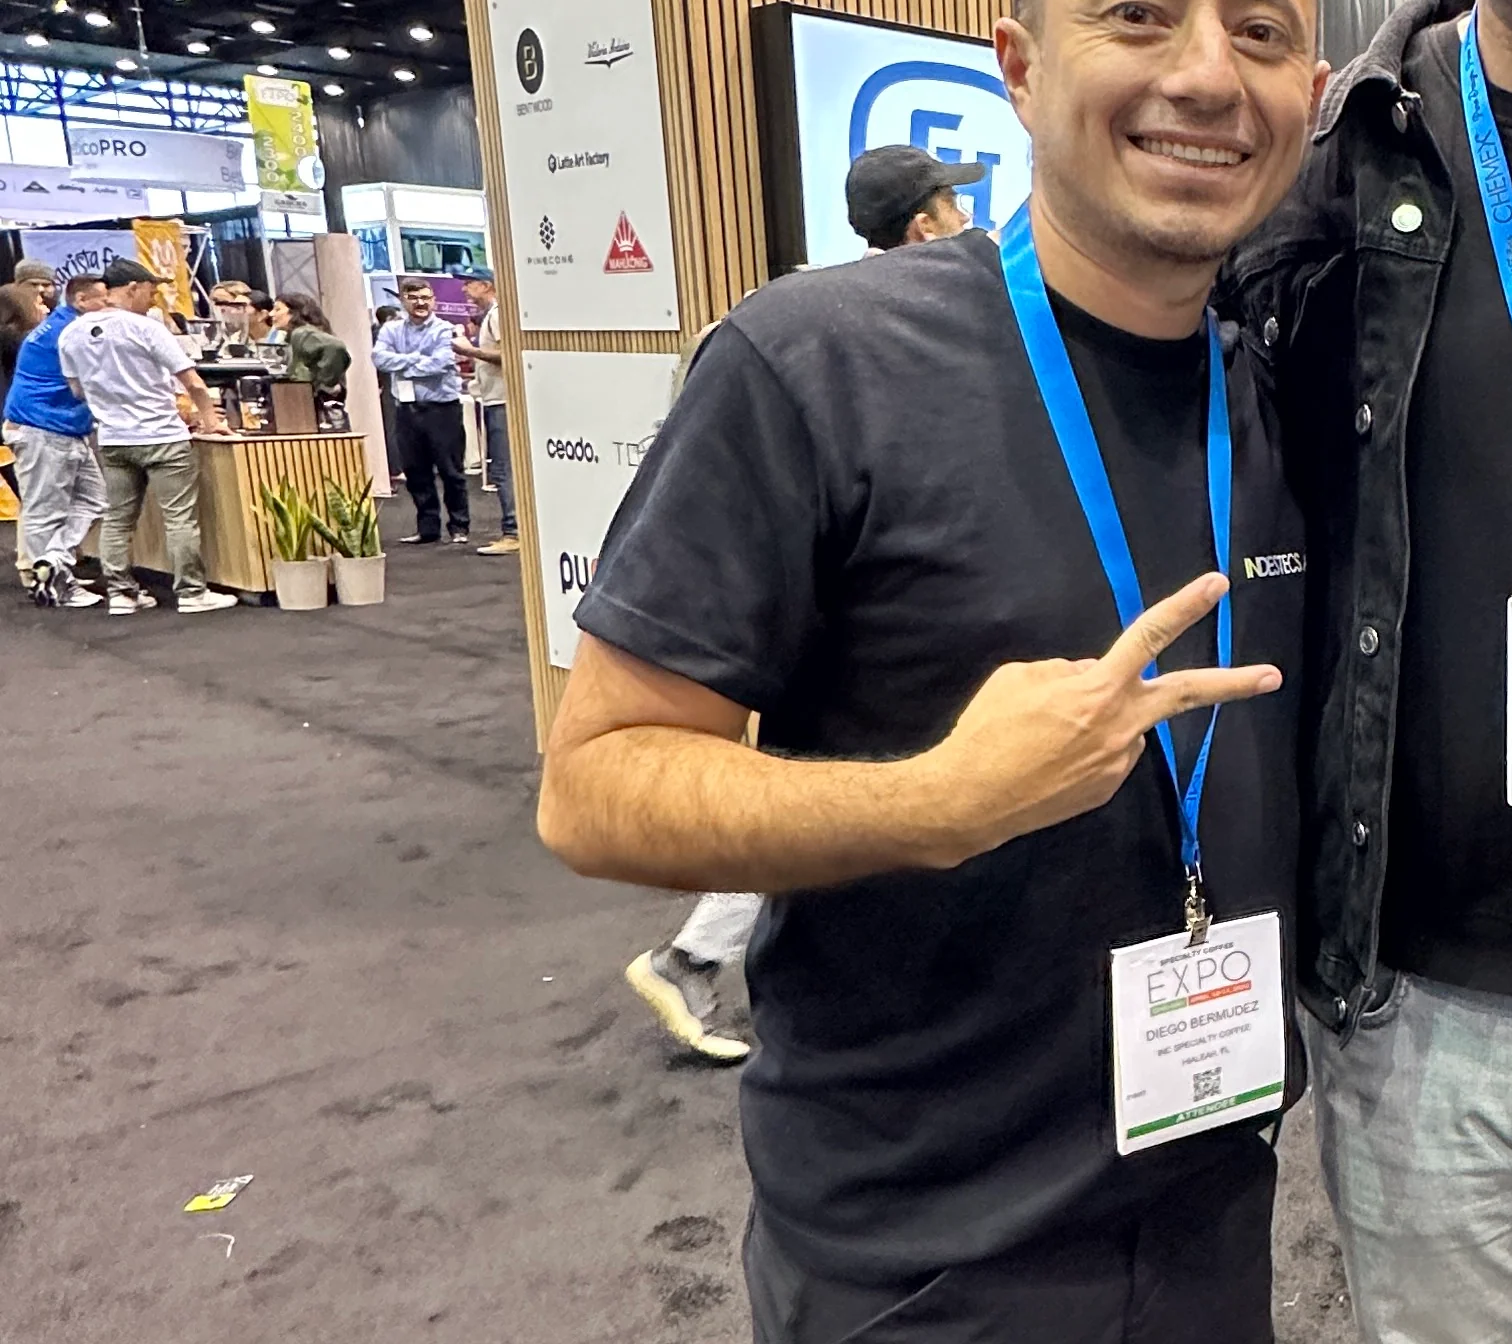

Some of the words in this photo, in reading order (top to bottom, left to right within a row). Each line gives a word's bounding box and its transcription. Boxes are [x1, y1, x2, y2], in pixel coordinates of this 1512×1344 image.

[1147, 950, 1251, 1004] EXPO
[1145, 1020, 1188, 1042] DIEGO
[1190, 999, 1260, 1029] BERMUDEZ
